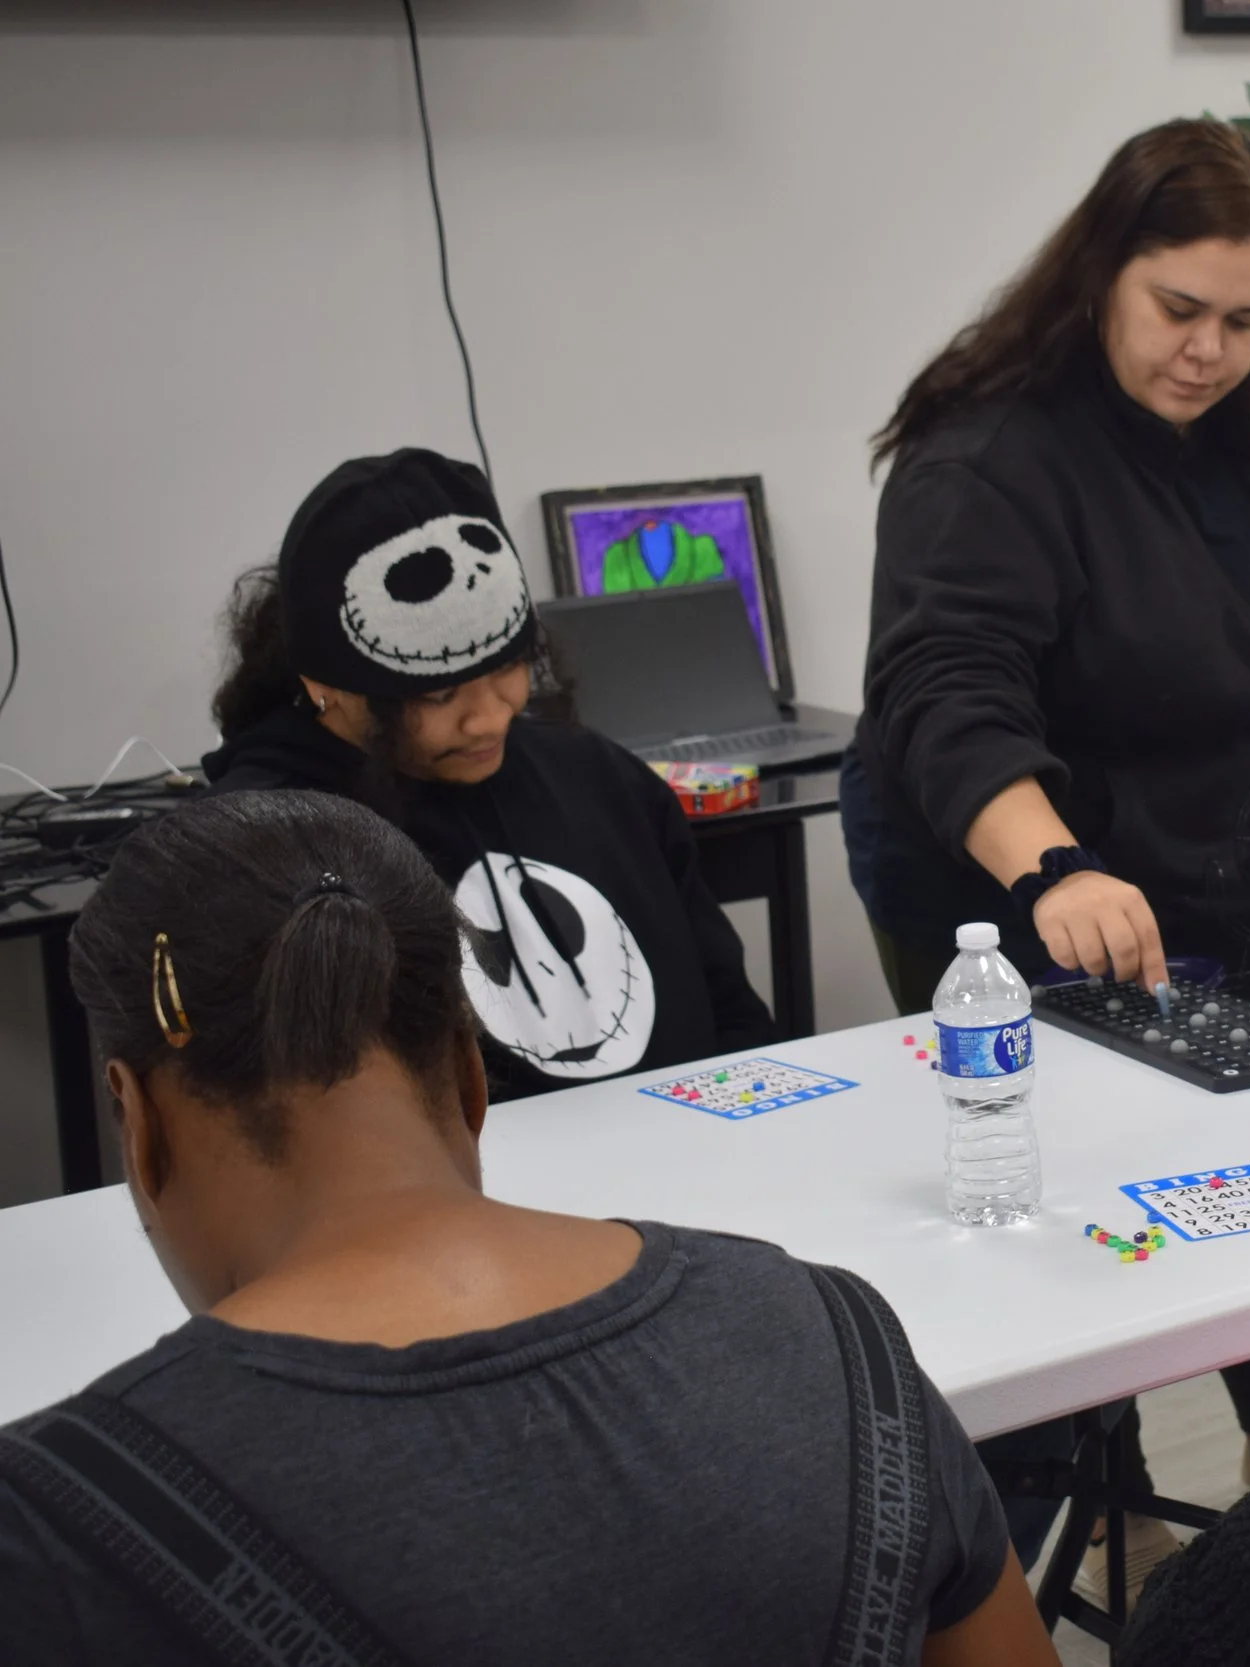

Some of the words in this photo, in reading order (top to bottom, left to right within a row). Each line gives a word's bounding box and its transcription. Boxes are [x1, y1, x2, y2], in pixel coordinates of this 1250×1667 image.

[1003, 1023, 1028, 1043] Pure
[1007, 1038, 1027, 1057] Life
[1173, 1186, 1202, 1196] 20
[1186, 1196, 1213, 1204] 16
[1218, 1190, 1244, 1199] 40
[1167, 1210, 1192, 1218] 11
[1197, 1204, 1226, 1213] 25
[1208, 1213, 1235, 1222] 29
[1197, 1228, 1212, 1236] 8
[1221, 1222, 1247, 1231] 19
[872, 1409, 909, 1557] MADDEN
